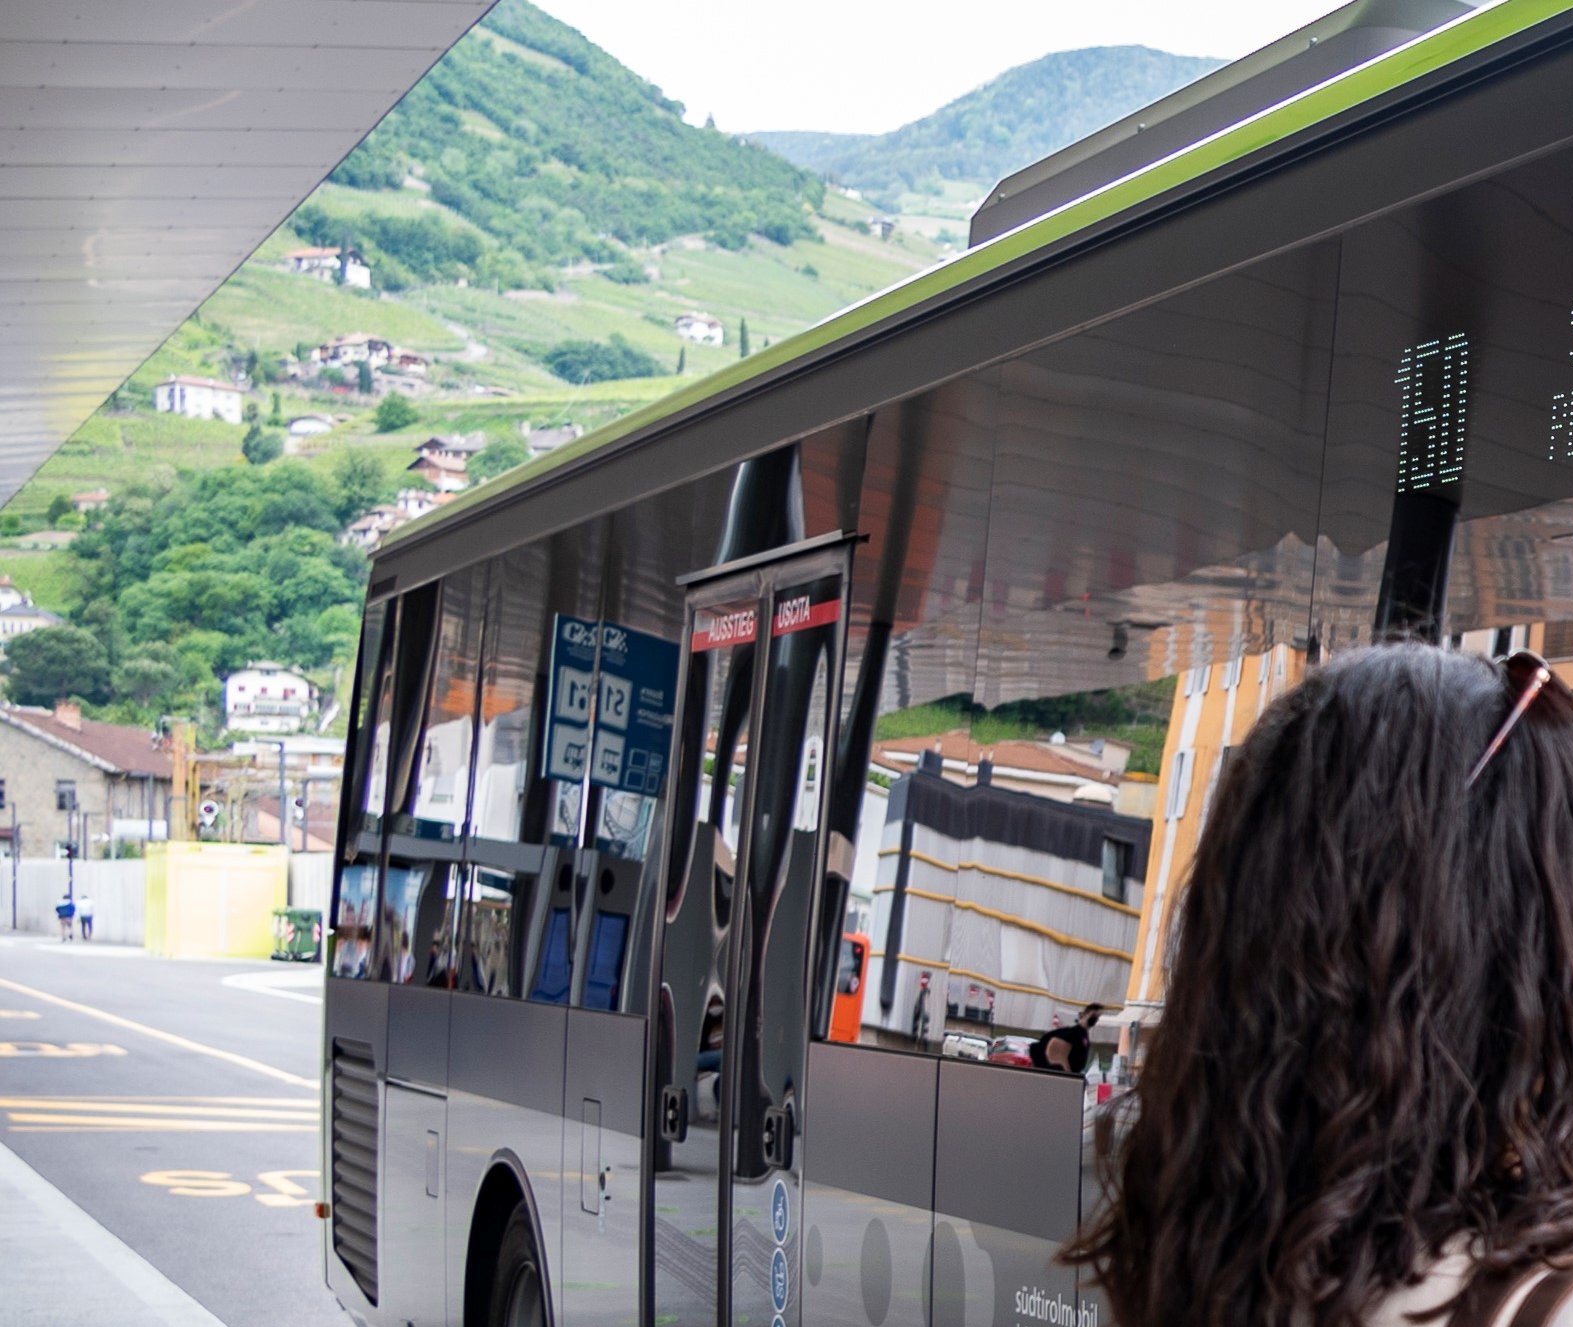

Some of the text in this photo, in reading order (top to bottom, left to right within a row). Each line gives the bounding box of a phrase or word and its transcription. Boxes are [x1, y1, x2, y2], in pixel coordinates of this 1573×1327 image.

[1394, 332, 1469, 492] 150
[708, 610, 754, 642] AUSSTIEG
[777, 595, 810, 628] USCITA
